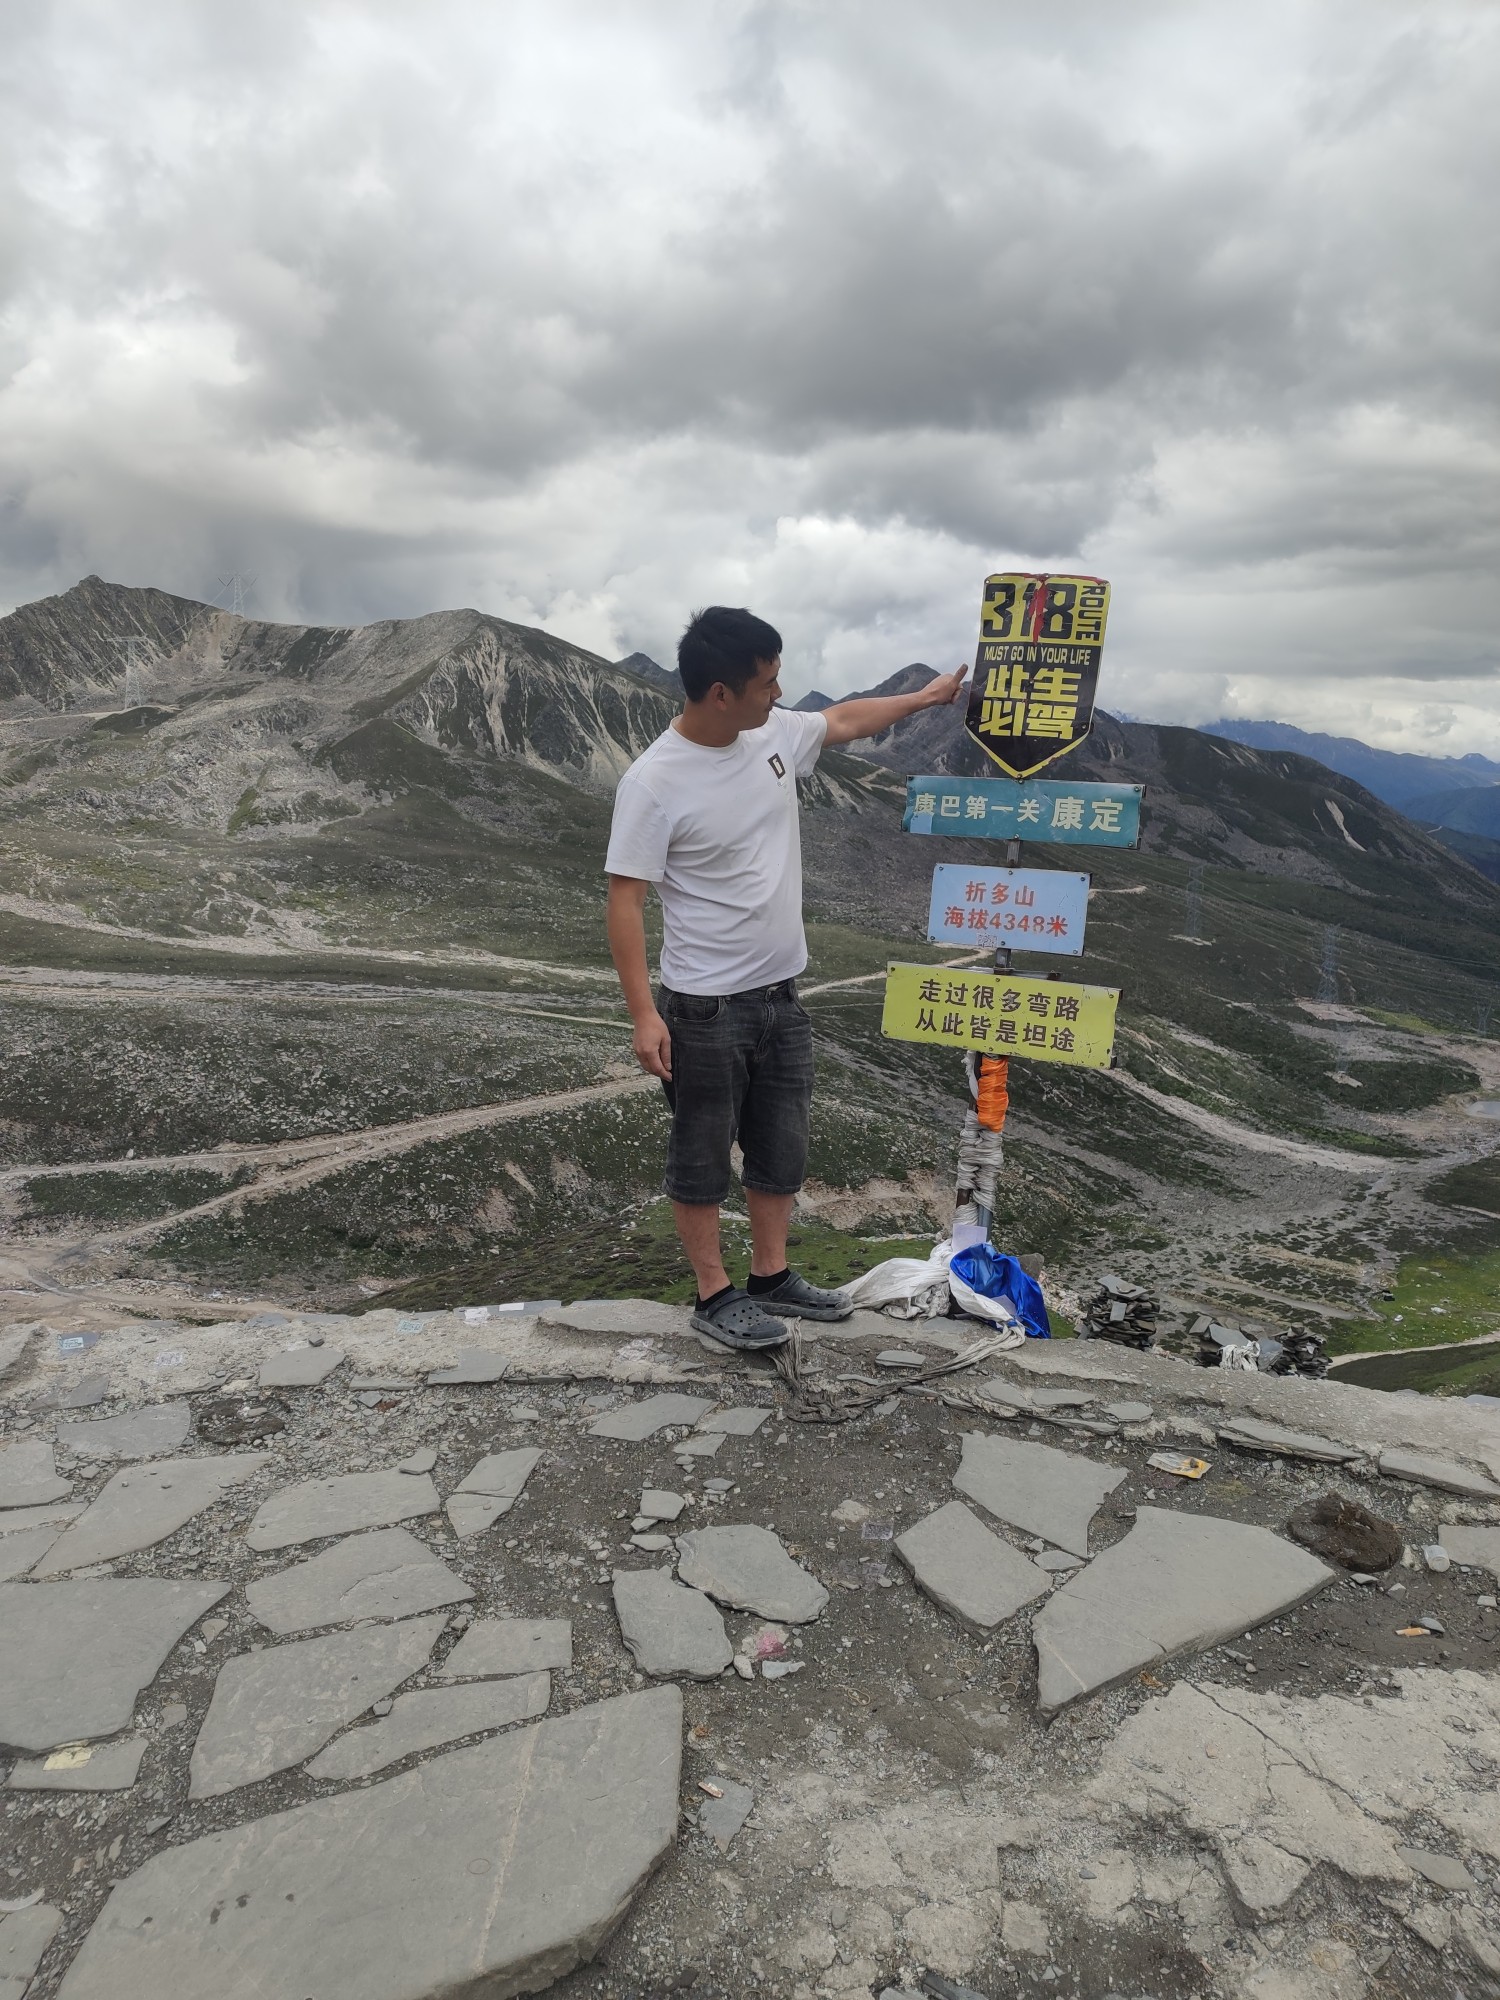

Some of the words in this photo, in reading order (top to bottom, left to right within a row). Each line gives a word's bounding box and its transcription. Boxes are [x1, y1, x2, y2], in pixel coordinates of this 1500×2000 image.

[983, 583, 1077, 639] 318
[1075, 585, 1106, 641] ROUTE
[984, 645, 1009, 661] MUST
[1010, 646, 1024, 661] GO
[1027, 646, 1038, 662] IN
[1040, 647, 1068, 665] YOUR
[1070, 649, 1091, 665] LIFE
[984, 664, 1082, 703] 此生
[978, 700, 1077, 740] 必驾
[1050, 796, 1123, 833] 康定
[965, 881, 1035, 907] 折多山
[943, 906, 1068, 937] 海拔4348米
[918, 978, 1080, 1022] 走过很多弯路
[915, 1008, 1076, 1052] 从此皆是坦途
